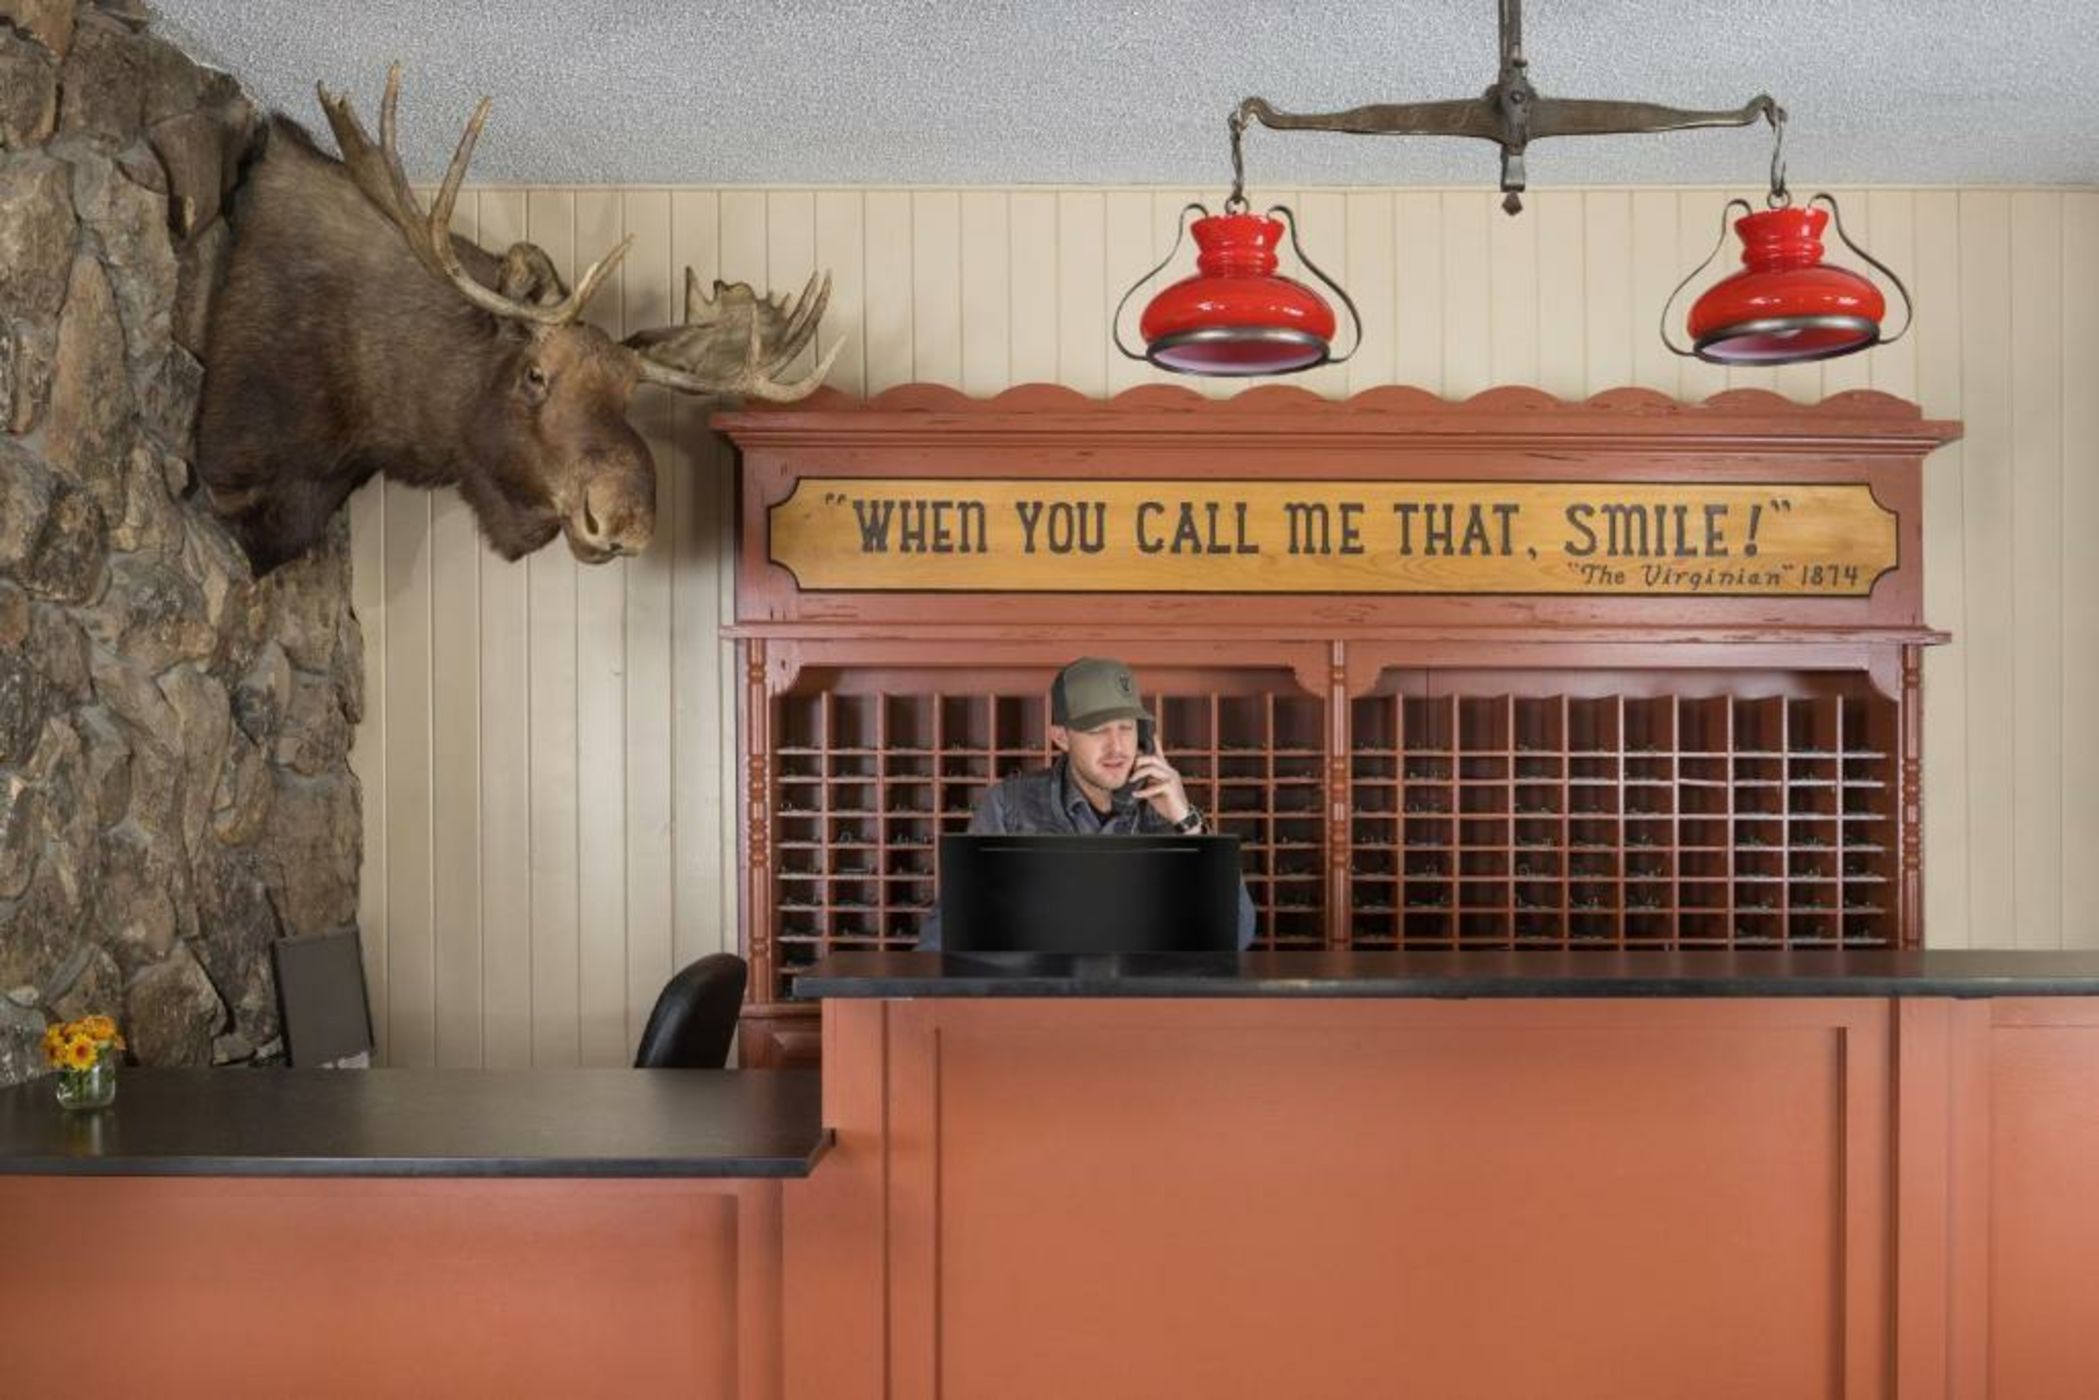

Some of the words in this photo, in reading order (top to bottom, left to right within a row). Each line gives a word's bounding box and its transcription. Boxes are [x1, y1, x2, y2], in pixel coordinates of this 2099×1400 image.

[1015, 501, 1106, 555] YOU
[1136, 501, 1260, 555] CALL
[1284, 502, 1365, 555] ME
[1394, 503, 1537, 560] THAT,
[1801, 564, 1859, 587] 1874
